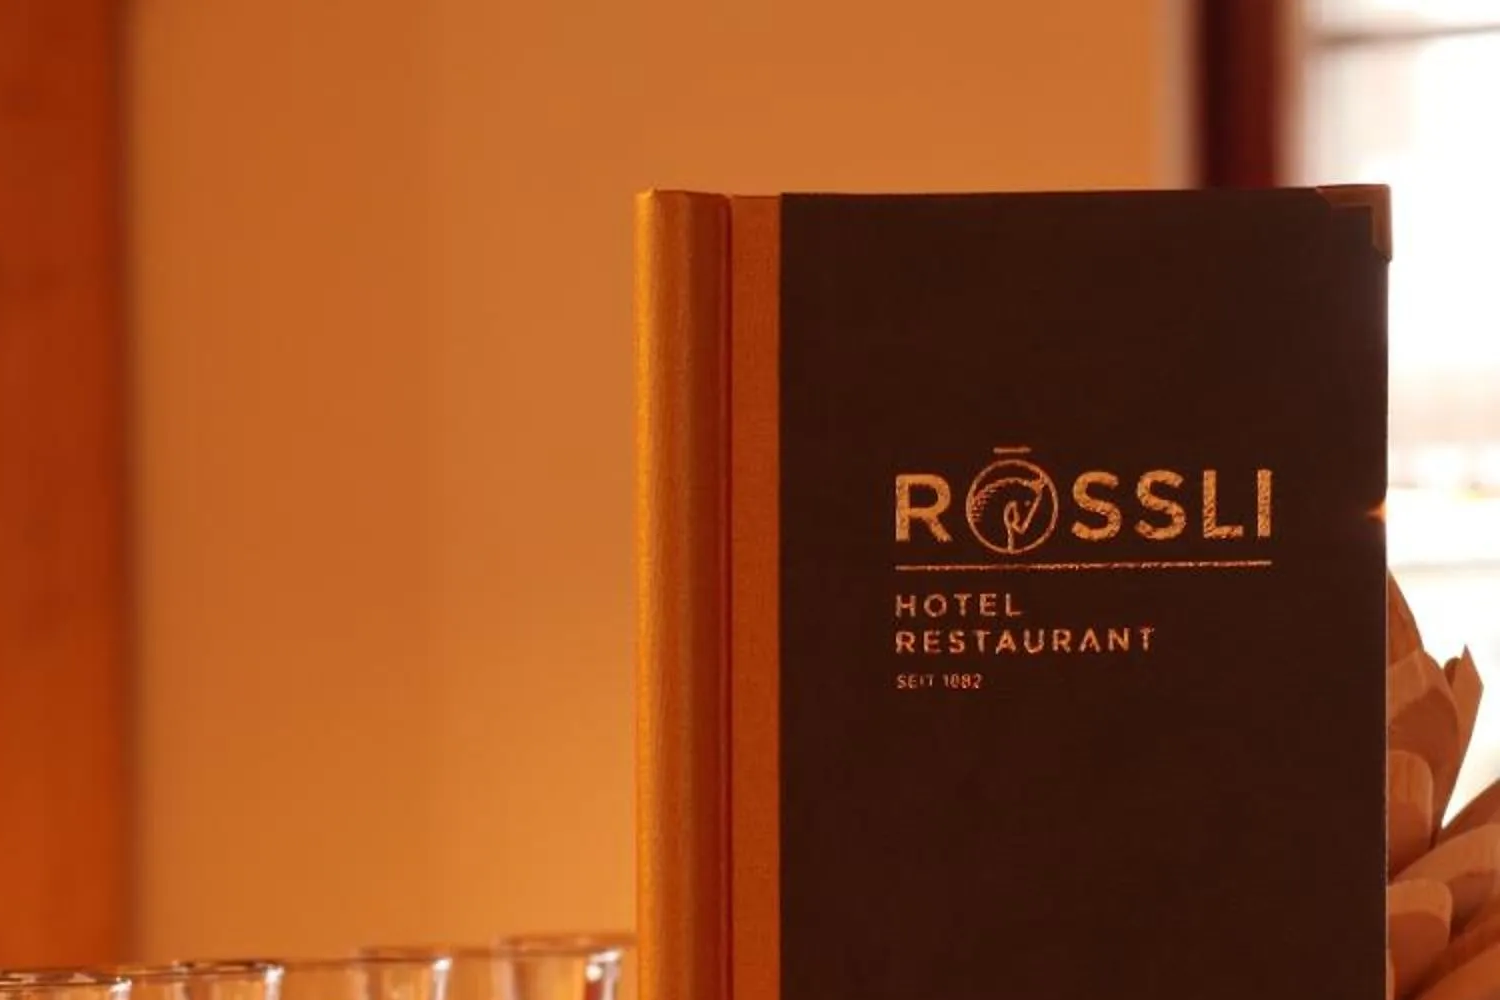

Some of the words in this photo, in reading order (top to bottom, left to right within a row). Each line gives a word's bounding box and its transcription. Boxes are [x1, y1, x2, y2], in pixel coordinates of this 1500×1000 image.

[895, 592, 1022, 618] HOTEL
[895, 626, 1155, 655] RESTAURANT
[895, 673, 934, 689] SEIT
